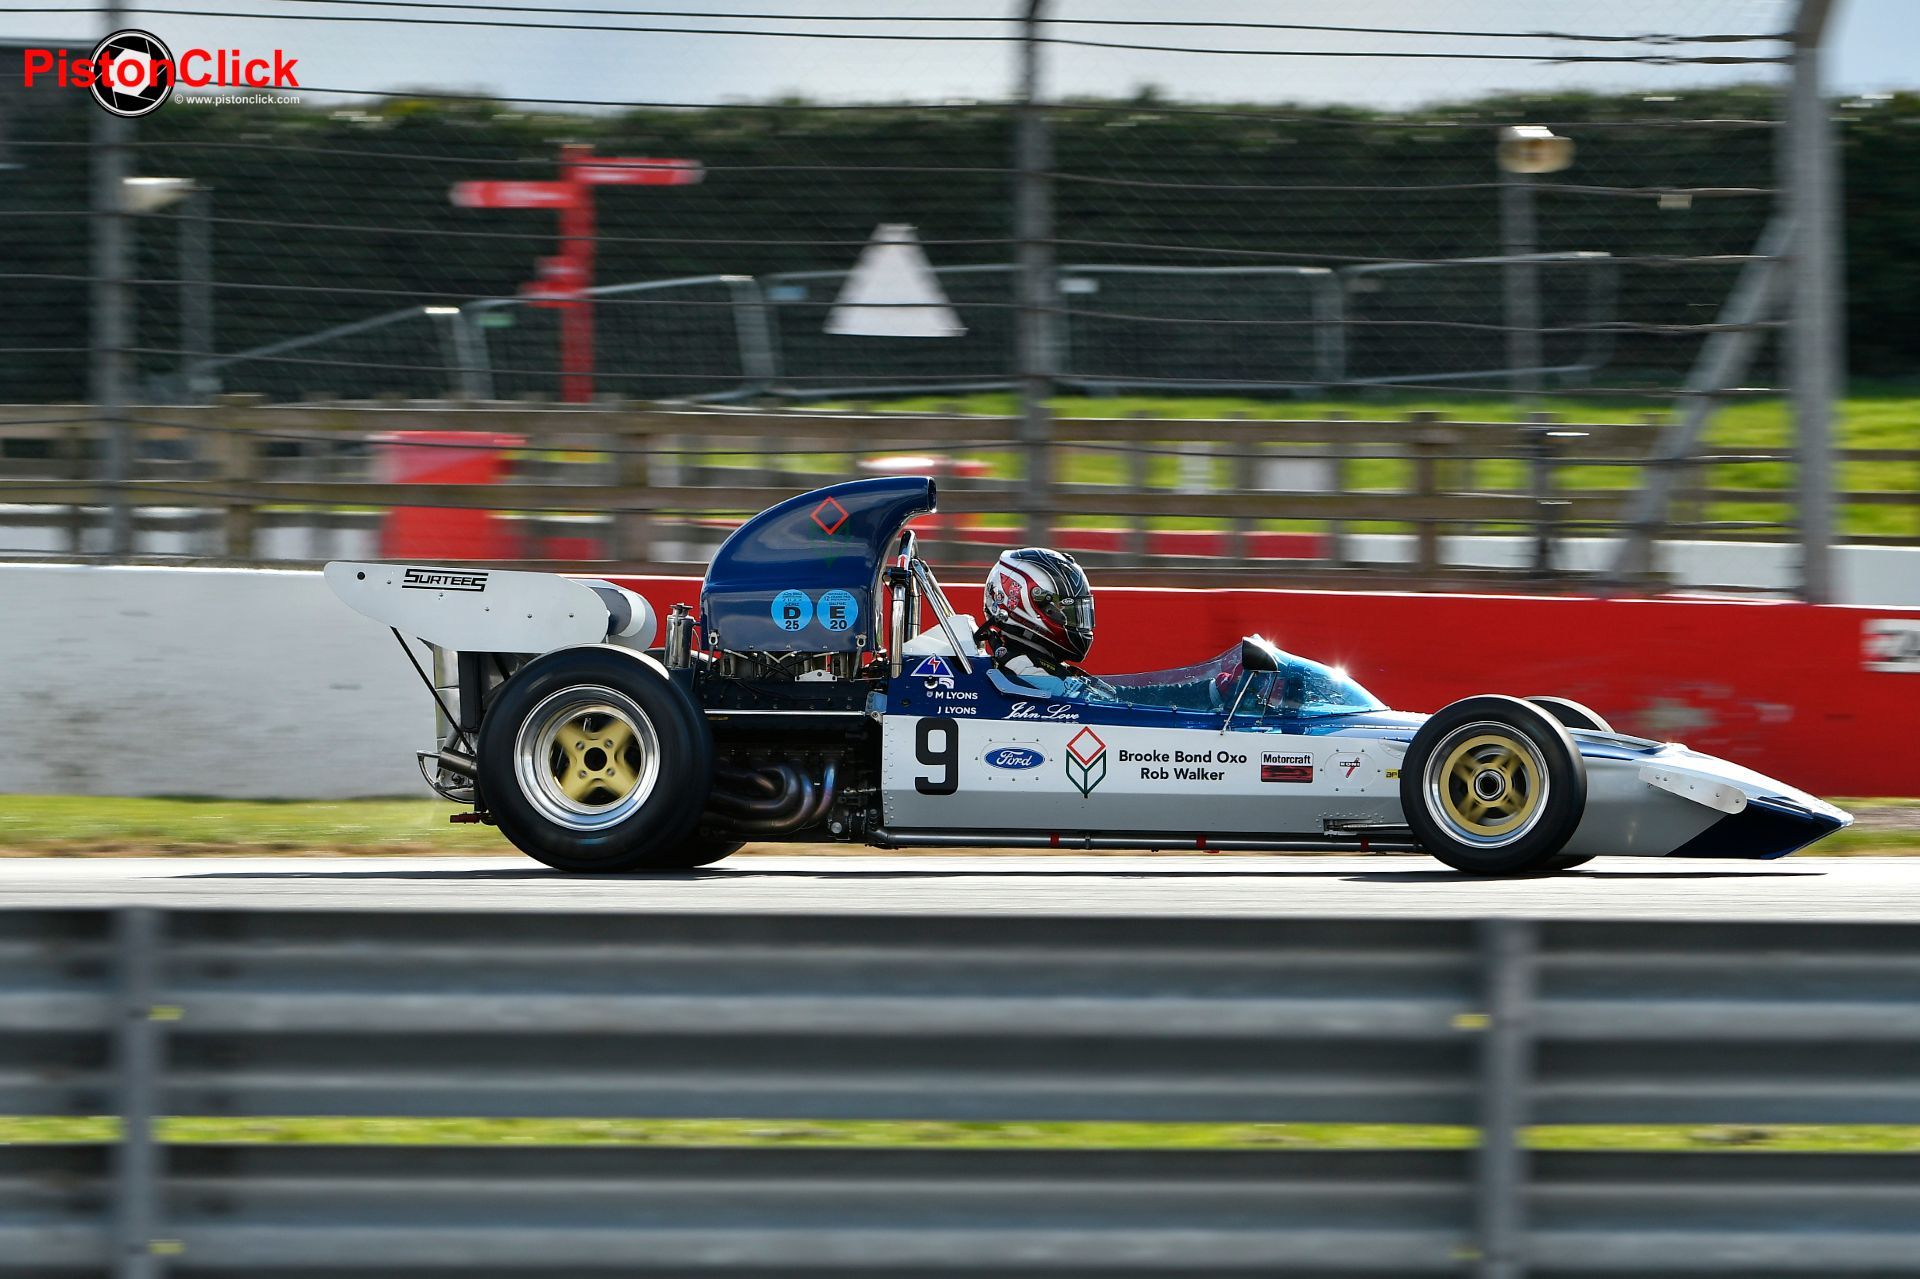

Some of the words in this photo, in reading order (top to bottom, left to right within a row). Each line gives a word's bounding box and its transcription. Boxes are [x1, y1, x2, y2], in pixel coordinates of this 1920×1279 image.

[402, 568, 489, 592] SURTEES
[784, 607, 801, 619] D
[830, 606, 846, 619] E
[785, 620, 799, 629] 25
[830, 620, 847, 629] 20
[935, 691, 944, 699] M
[946, 691, 978, 700] LYONS
[937, 706, 942, 714] J
[944, 706, 977, 715] LYONS
[1001, 701, 1040, 720] John
[1041, 704, 1080, 720] Love
[914, 717, 959, 796] 9
[996, 750, 1032, 767] Ford
[1119, 750, 1170, 763] Brooke
[1174, 751, 1212, 763] Bond
[1216, 752, 1248, 764] Oxo
[1263, 753, 1312, 765] Motorcraft
[1140, 767, 1169, 780] Rob
[1174, 768, 1225, 781] Walker
